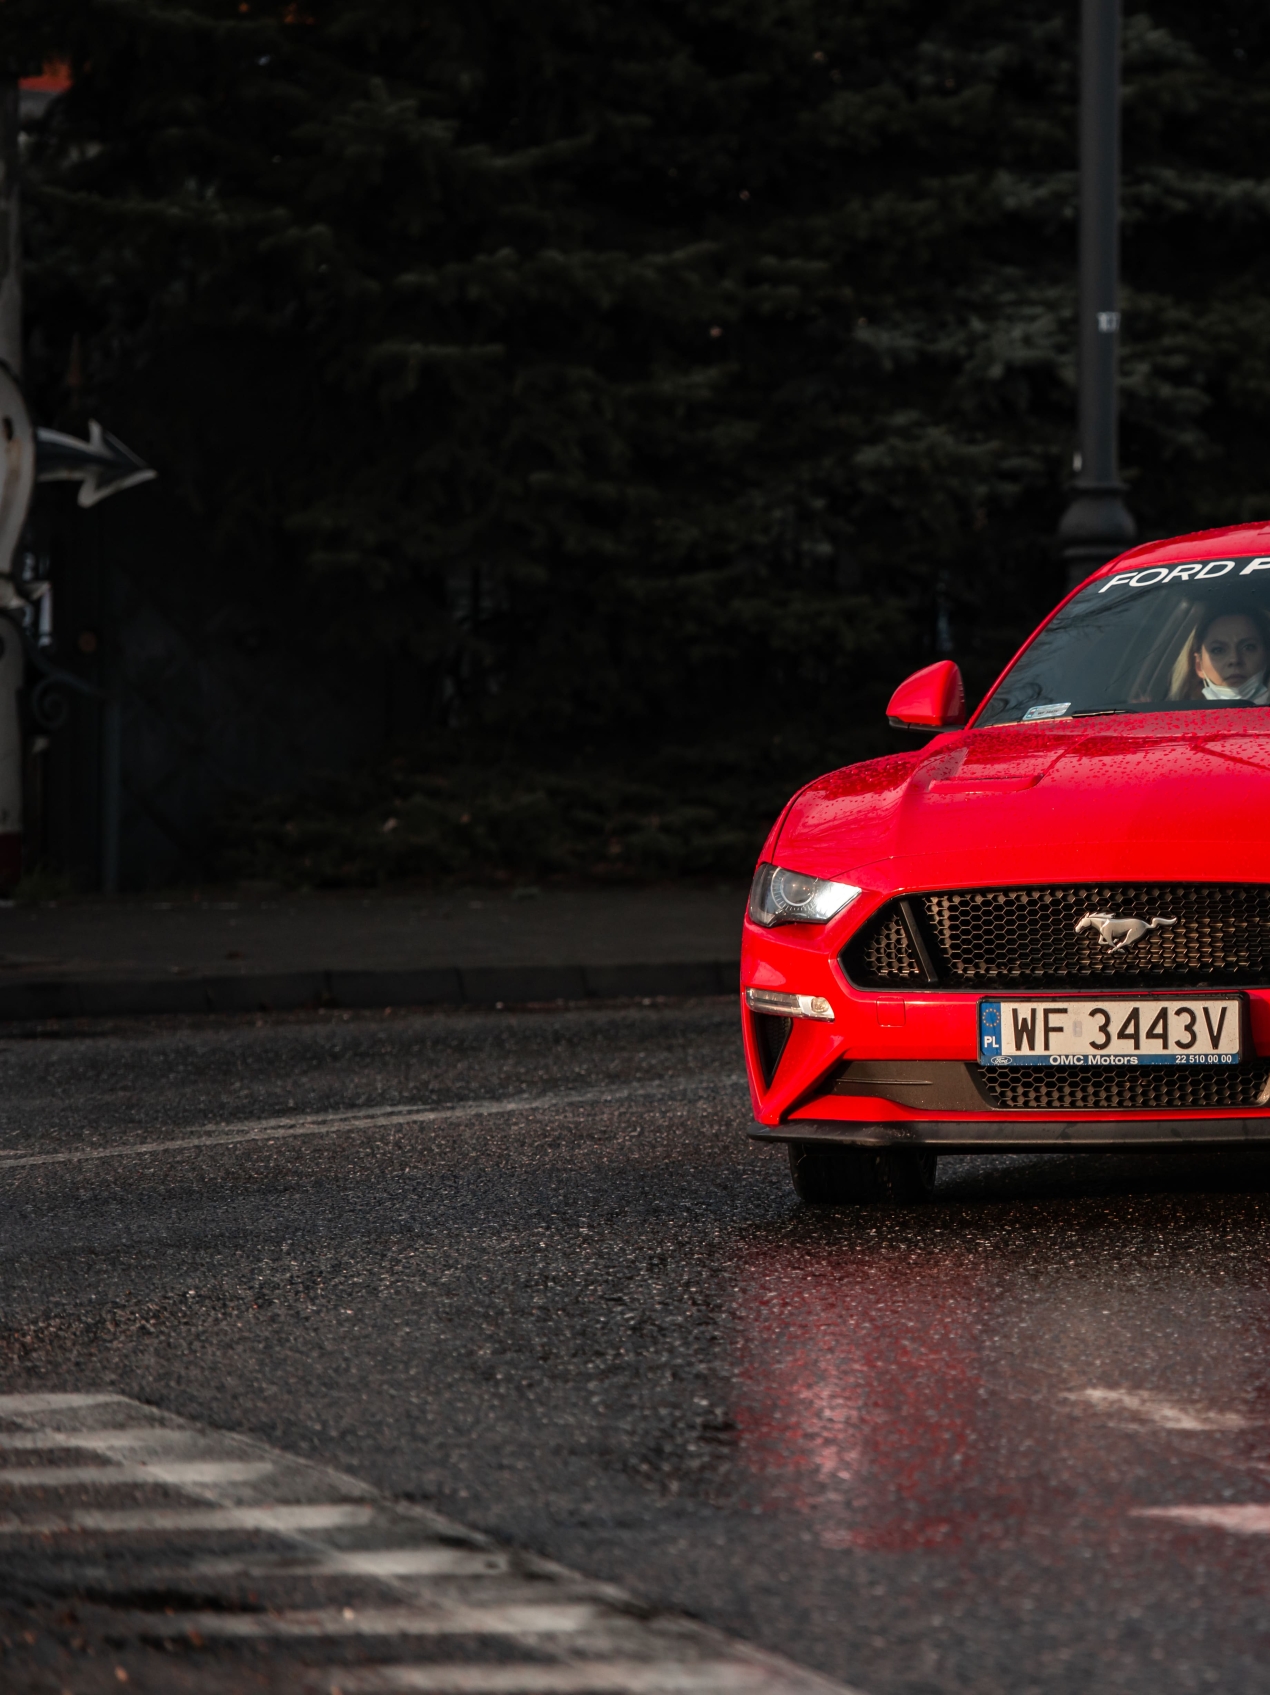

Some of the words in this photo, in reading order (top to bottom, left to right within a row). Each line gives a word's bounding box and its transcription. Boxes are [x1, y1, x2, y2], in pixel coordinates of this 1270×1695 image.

[1097, 560, 1236, 594] FORD
[1011, 1007, 1068, 1051] WF
[1088, 1006, 1228, 1051] 3443V
[983, 1035, 1000, 1048] PL
[1049, 1054, 1084, 1066] OMC
[1088, 1054, 1139, 1066] Motors
[1175, 1054, 1187, 1064] 22
[1189, 1054, 1205, 1064] 510
[1207, 1054, 1219, 1063] 00
[1221, 1054, 1233, 1063] 00
